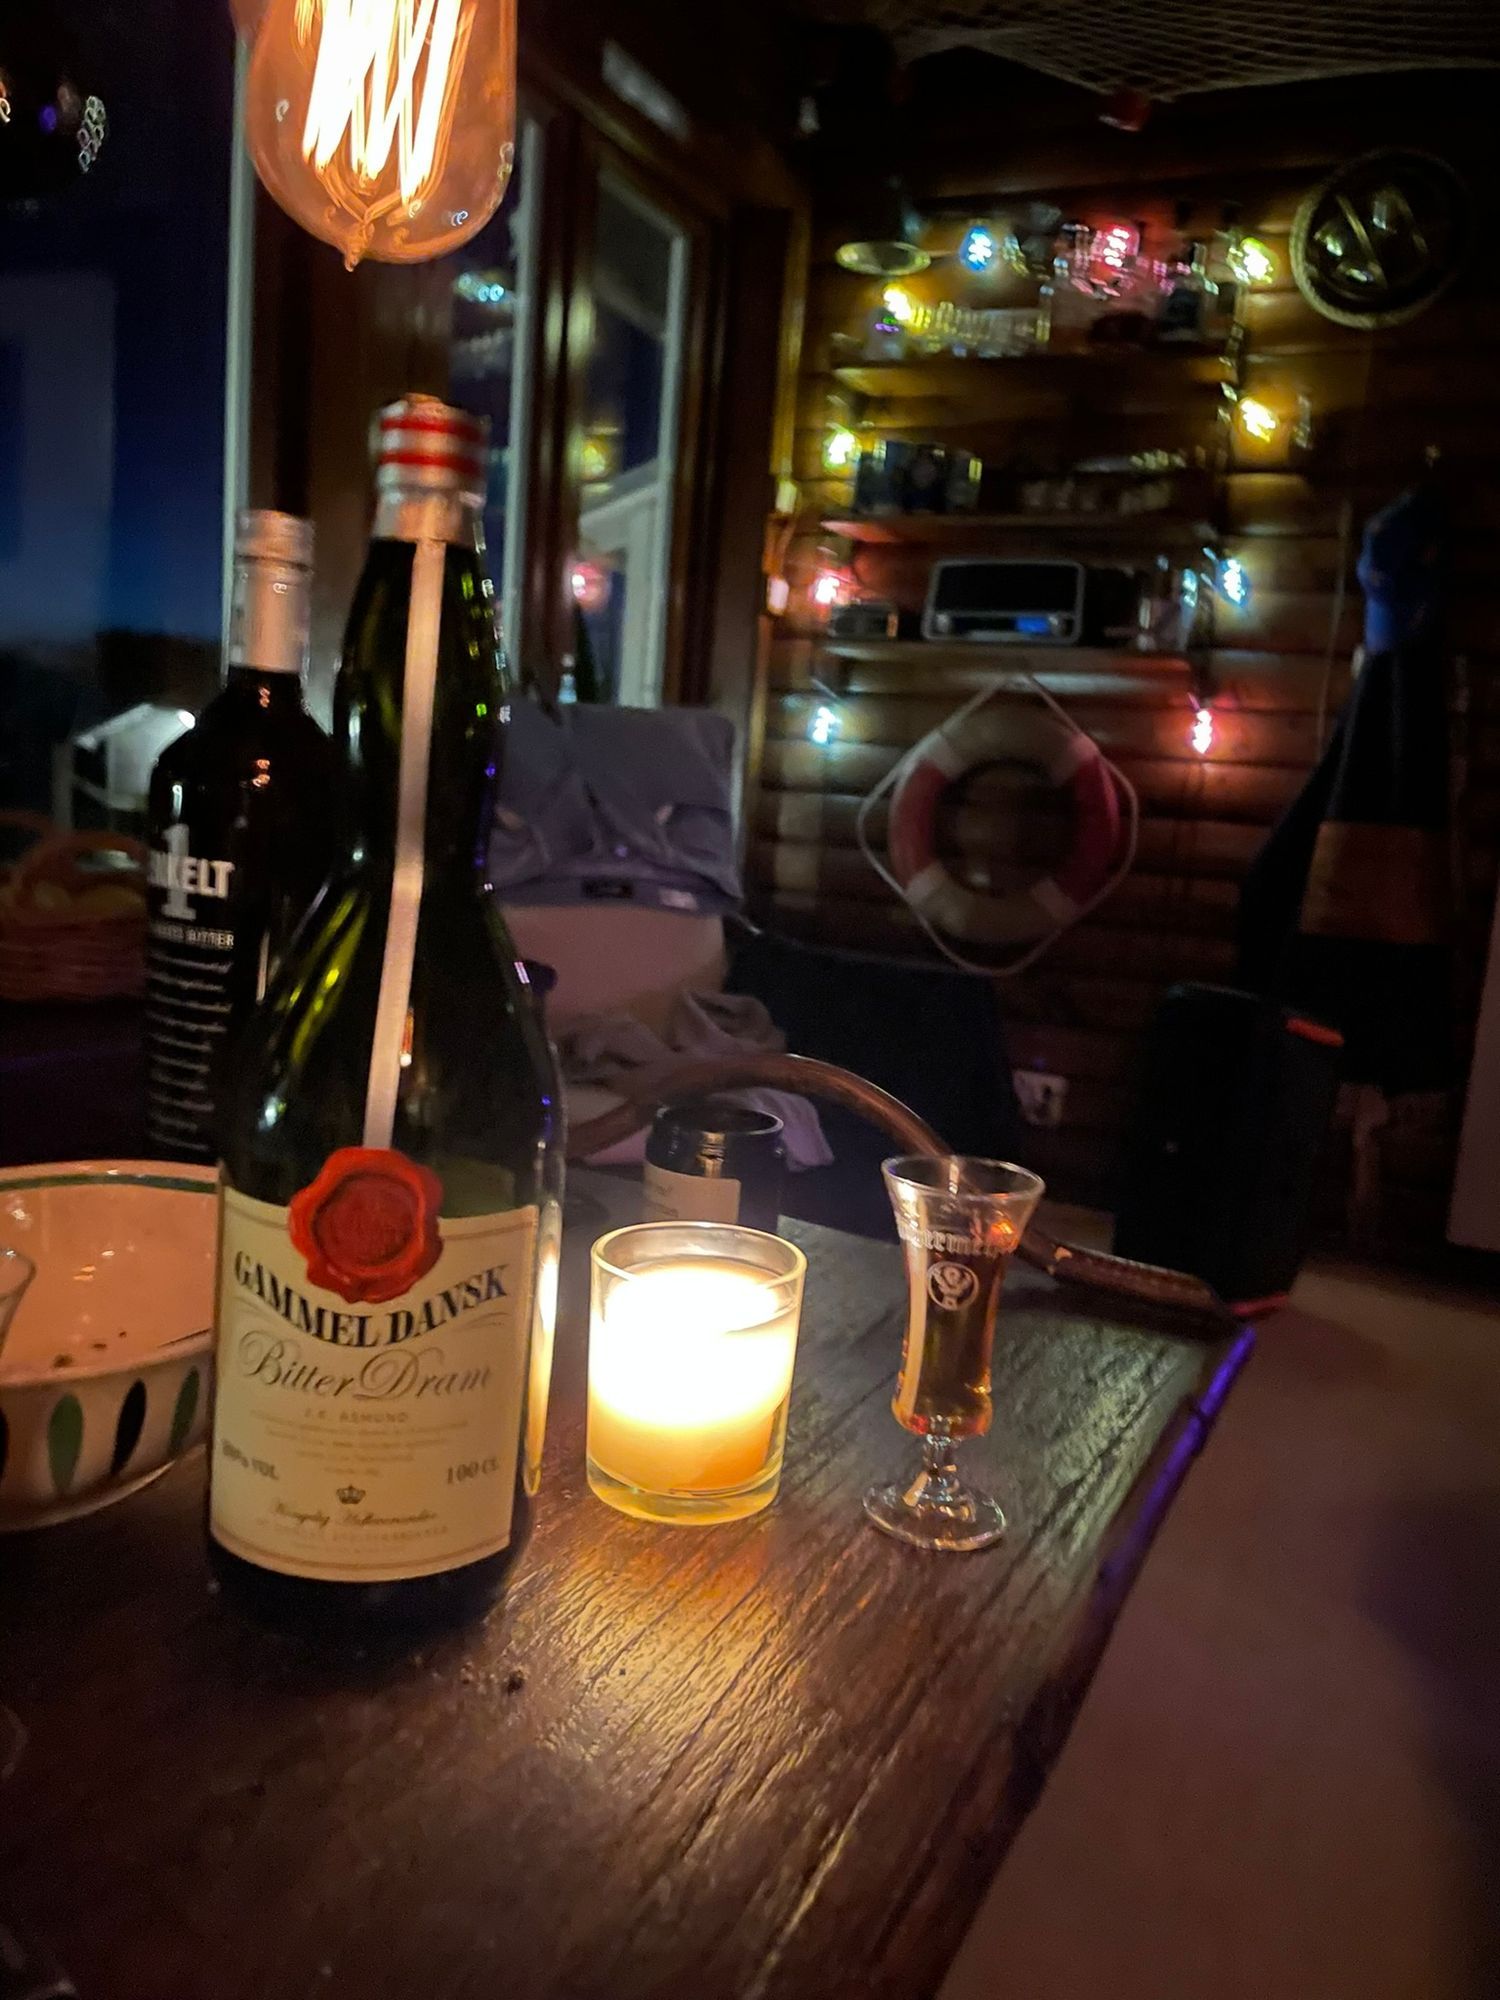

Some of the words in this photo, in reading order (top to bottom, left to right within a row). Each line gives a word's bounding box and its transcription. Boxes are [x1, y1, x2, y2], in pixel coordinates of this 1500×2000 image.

[184, 928, 235, 954] BITTER
[234, 1249, 379, 1348] GAMMEL
[387, 1263, 508, 1347] DANSK
[238, 1329, 355, 1397] Bitter
[352, 1347, 492, 1401] Dram
[447, 1461, 480, 1486] 100
